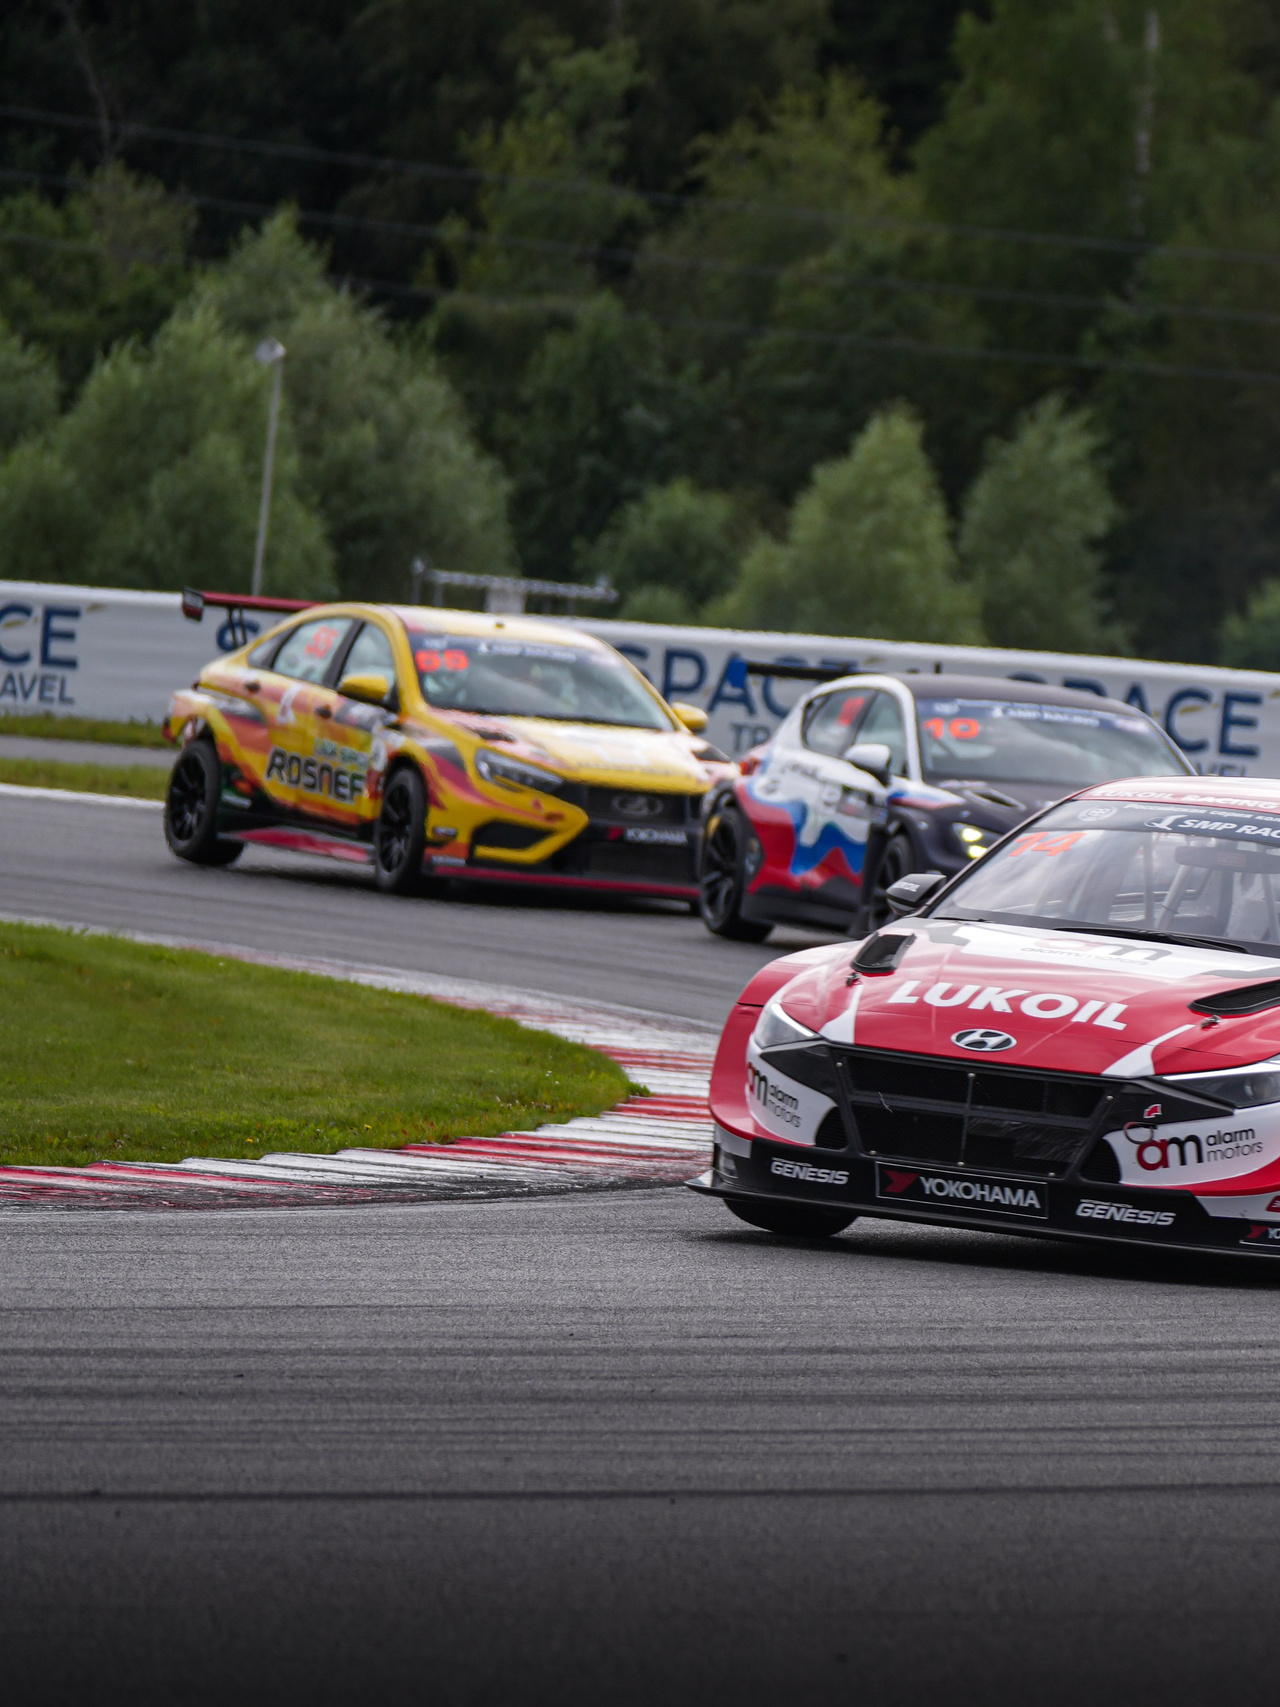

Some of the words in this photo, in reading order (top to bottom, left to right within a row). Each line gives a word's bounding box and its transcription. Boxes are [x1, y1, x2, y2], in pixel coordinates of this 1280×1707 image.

[922, 717, 981, 740] 10
[1091, 789, 1179, 802] LUKOIL
[1181, 793, 1279, 811] RACING
[1178, 818, 1238, 832] SMP
[1008, 831, 1087, 858] 14
[887, 980, 1129, 1031] LUKOIL
[769, 1083, 799, 1110] alarm
[768, 1099, 802, 1128] motors
[1205, 1127, 1256, 1147] alarm
[1136, 1134, 1205, 1171] am
[1206, 1140, 1264, 1163] motors
[770, 1160, 850, 1185] GENESIS
[919, 1175, 1042, 1209] YOKOHAMA
[1075, 1201, 1177, 1226] GENESIS
